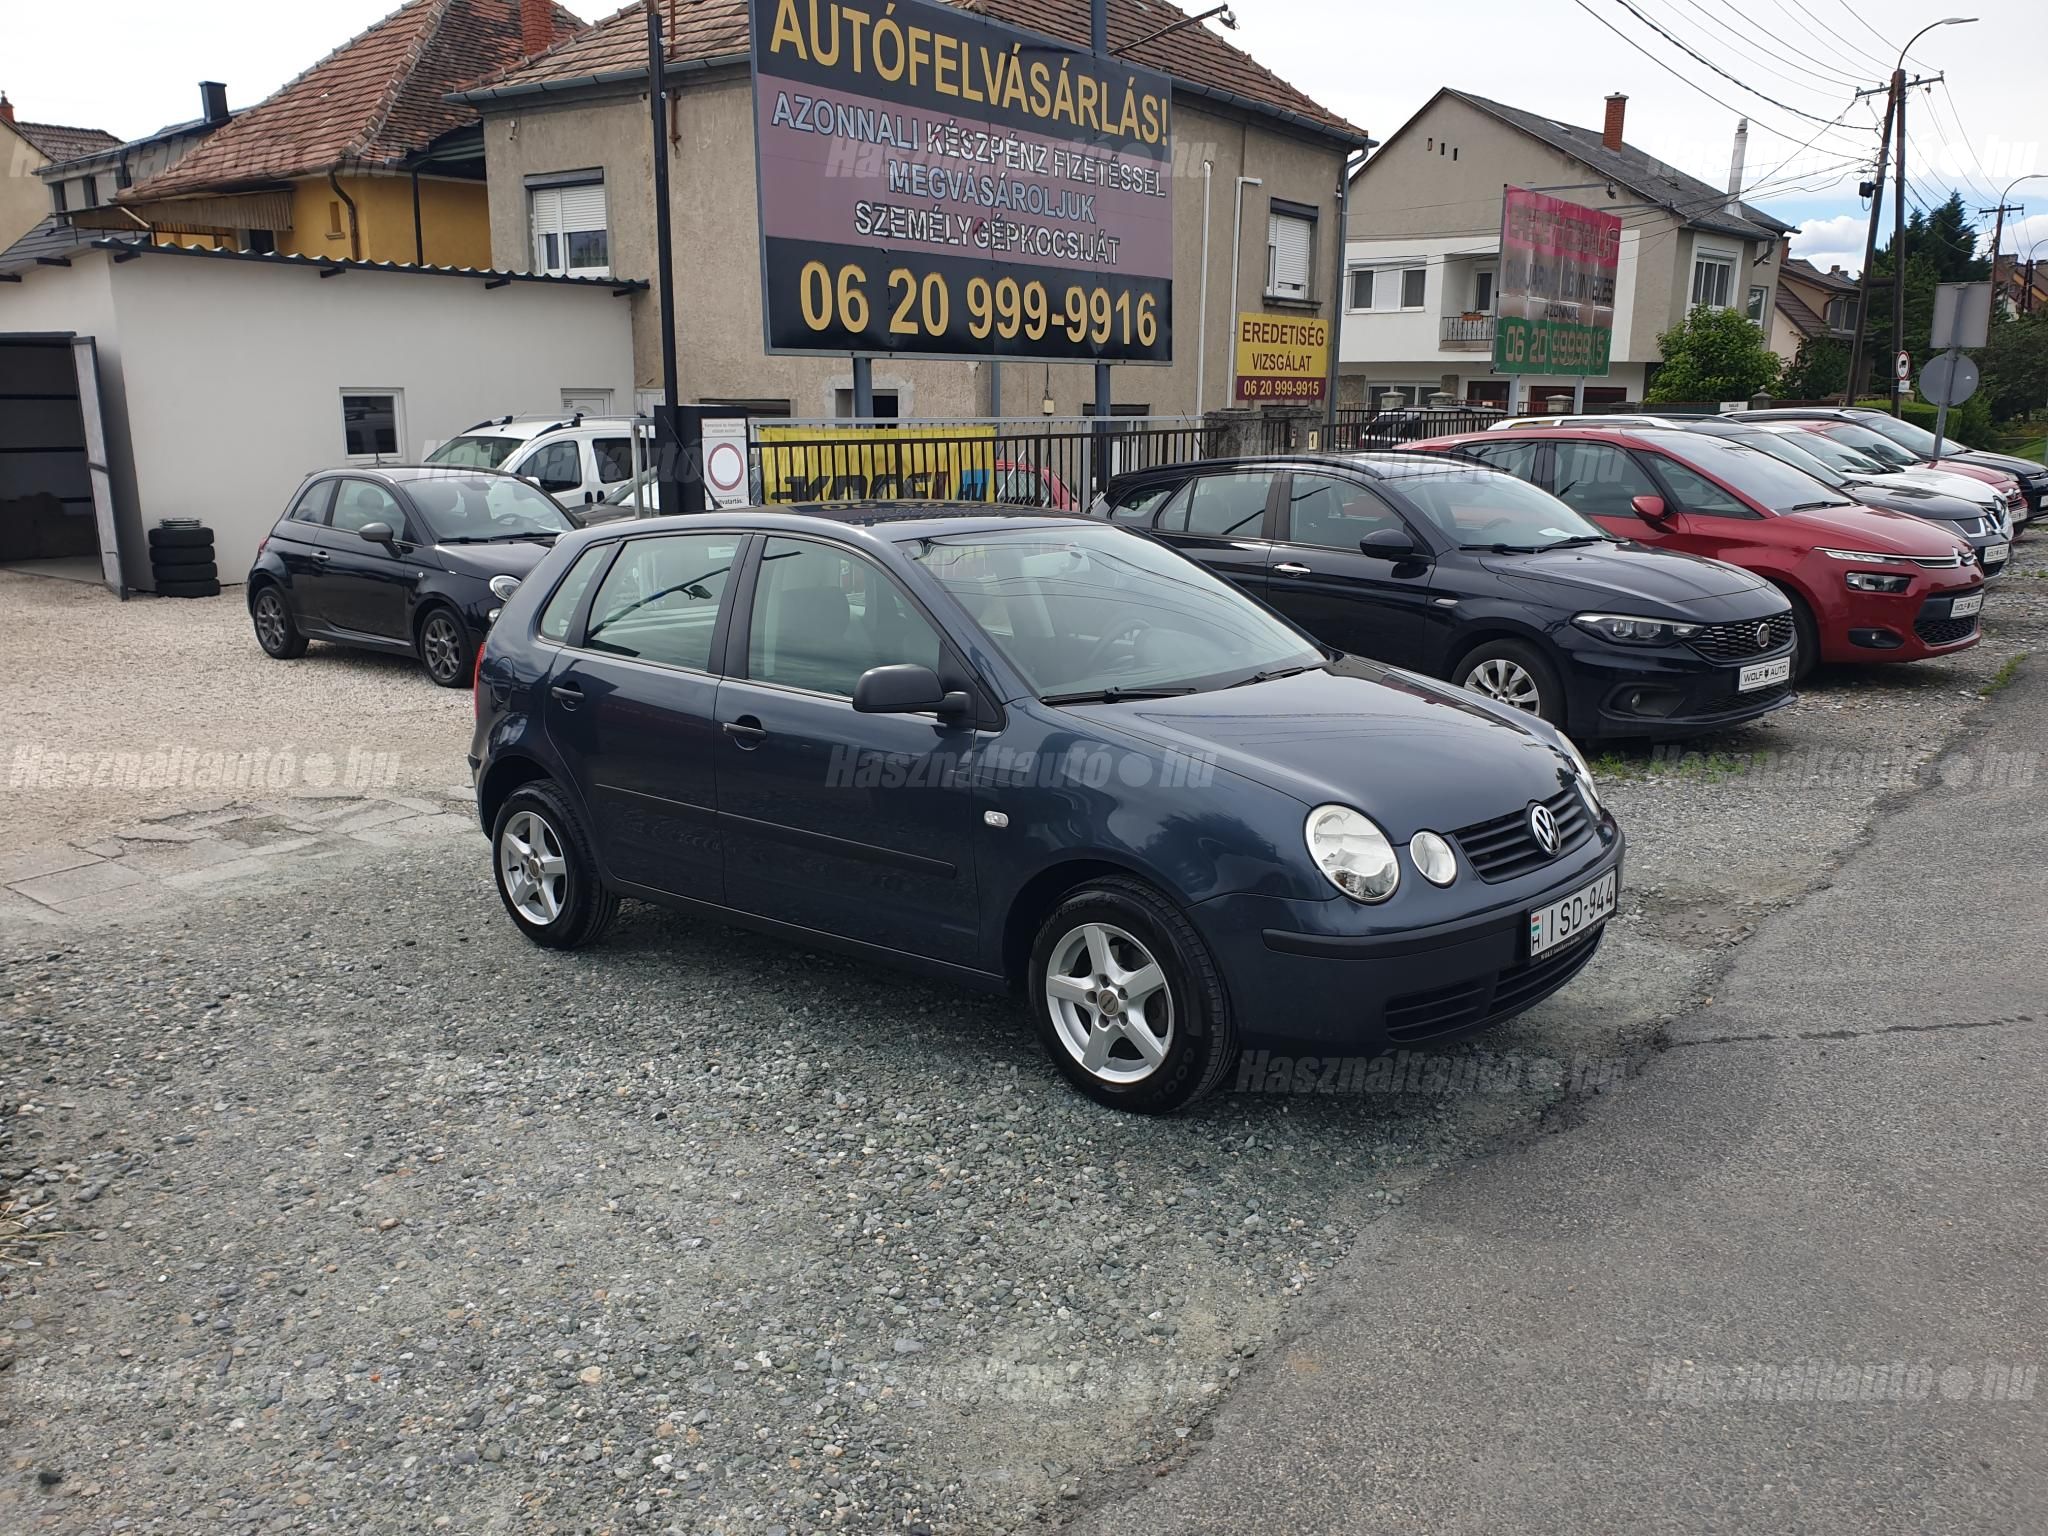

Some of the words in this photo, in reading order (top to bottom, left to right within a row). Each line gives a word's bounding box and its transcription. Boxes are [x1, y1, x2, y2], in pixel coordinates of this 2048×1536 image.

[770, 0, 1168, 146] AUTÓFELVÁSÁRLÁS!
[772, 91, 919, 151] AZONNALI
[926, 120, 1049, 175] KÉSZPÉNZ
[1053, 151, 1167, 198] FIZETÉSSEL
[888, 158, 1097, 224] MEGVÁSÁROLJUK
[854, 200, 1121, 266] SZEMÉLYGÉPKOCSIJÁT
[800, 260, 870, 332] 06
[888, 268, 949, 337] 20
[966, 276, 1158, 347] 999-9916
[1242, 321, 1324, 347] EREDETISÉG
[1505, 326, 1525, 362] 06
[1252, 351, 1312, 372] VIZSGÁLAT
[1244, 380, 1257, 395] 06
[1260, 380, 1272, 395] 20
[1275, 380, 1319, 396] 999-9915
[1744, 670, 1764, 682] WOLF
[1771, 665, 1786, 675] AUTO
[1532, 933, 1540, 951] H
